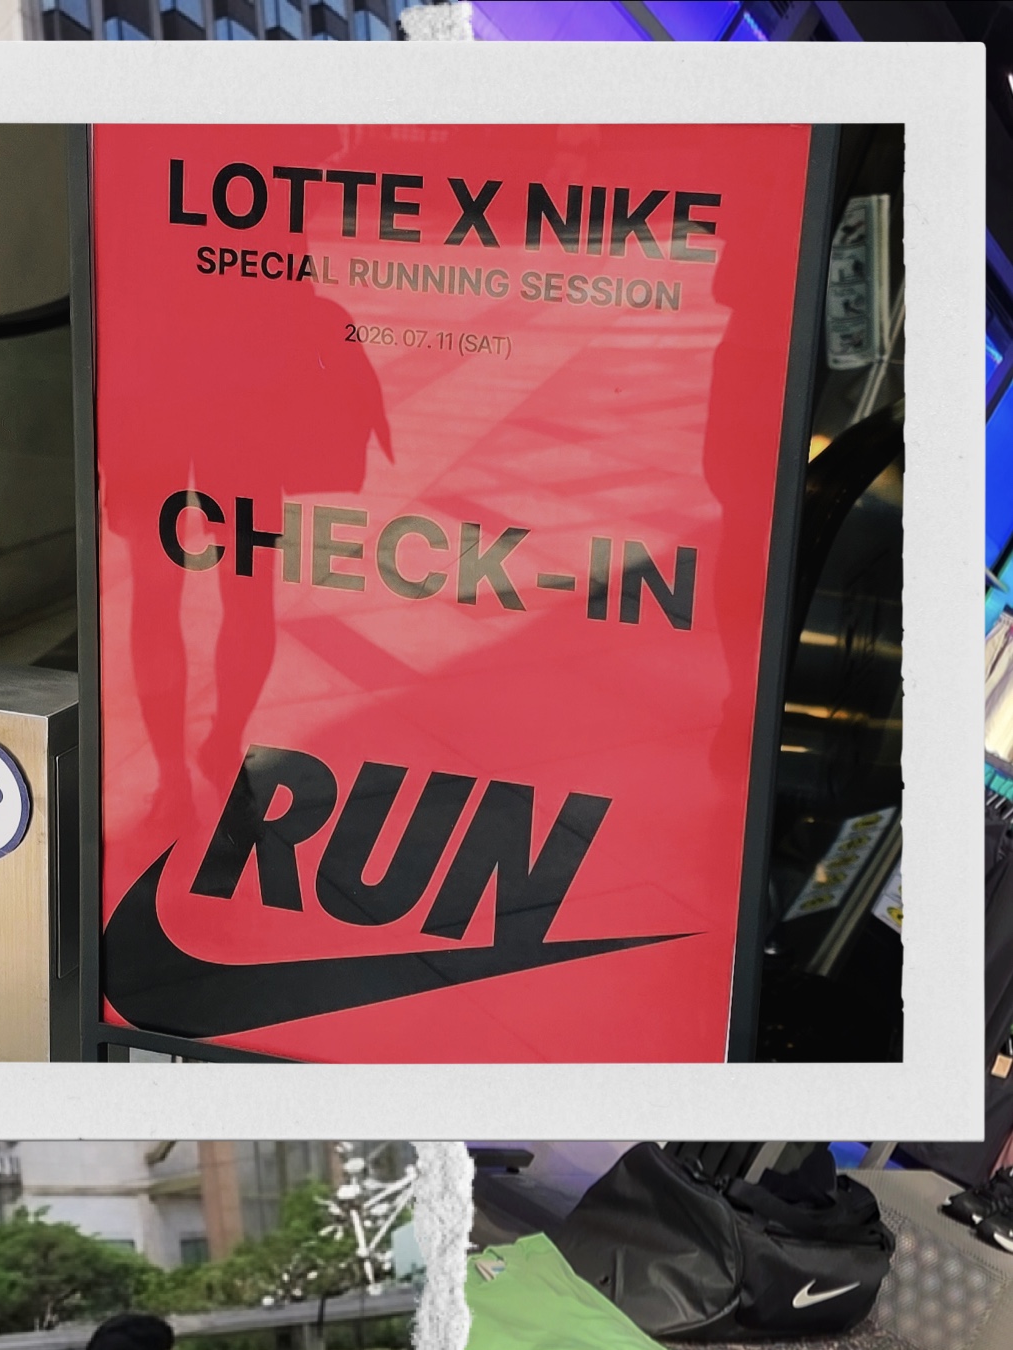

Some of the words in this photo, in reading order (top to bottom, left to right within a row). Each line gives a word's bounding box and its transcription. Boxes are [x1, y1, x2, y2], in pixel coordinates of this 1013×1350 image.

[168, 159, 425, 243] LOTTE
[444, 177, 503, 248] X
[524, 182, 722, 264] NIKE
[196, 246, 339, 285] SPECIAL
[348, 257, 510, 299] RUNNING
[520, 270, 682, 311] SESSION
[158, 489, 698, 631] CHECK-IN
[189, 744, 613, 946] RUN
